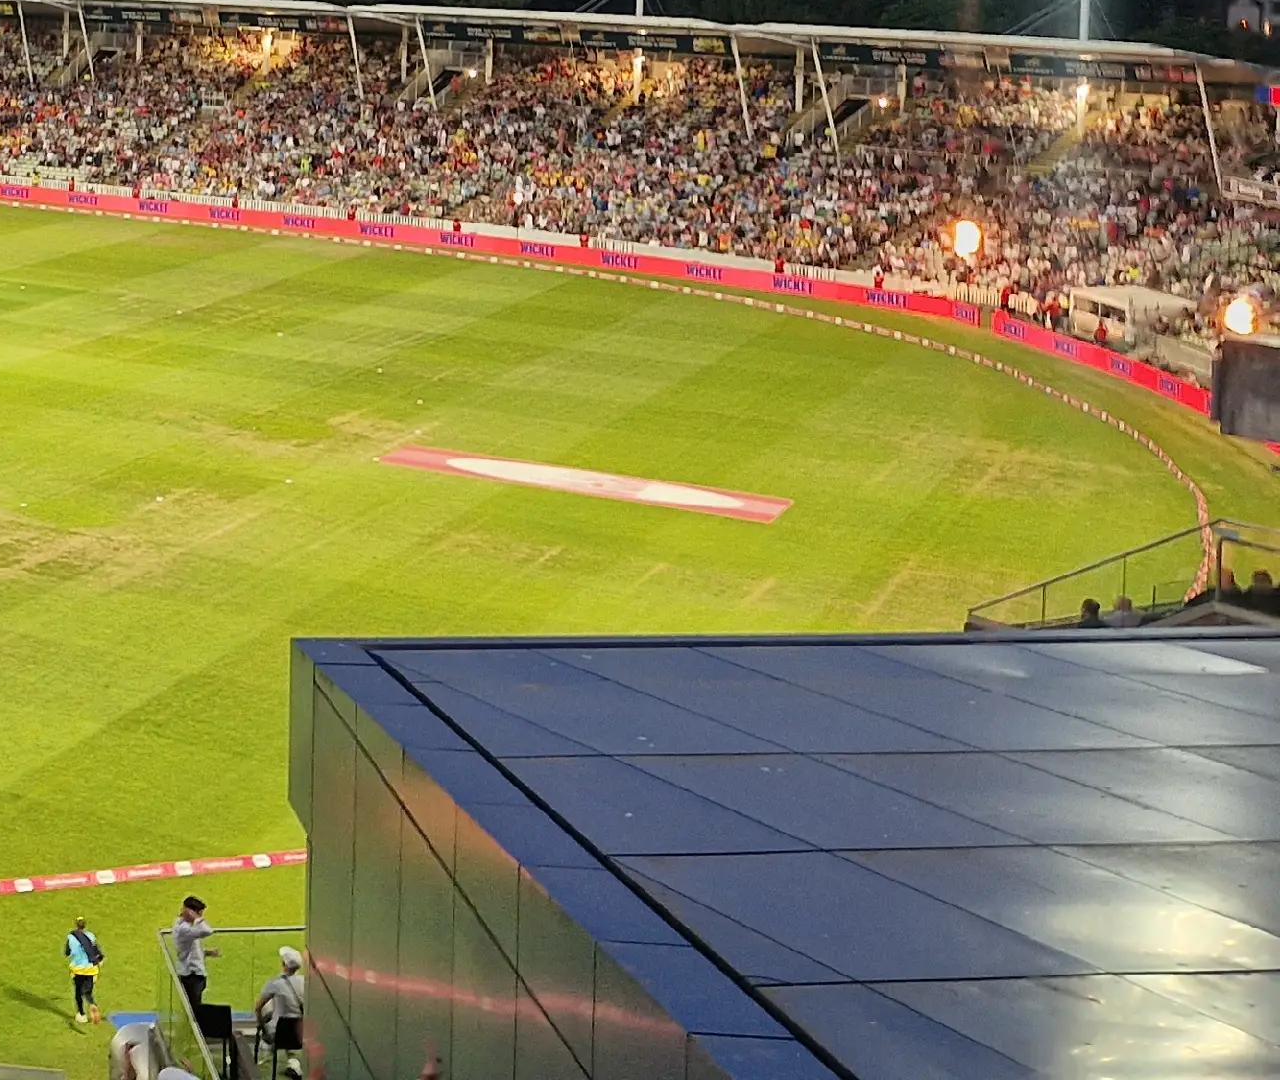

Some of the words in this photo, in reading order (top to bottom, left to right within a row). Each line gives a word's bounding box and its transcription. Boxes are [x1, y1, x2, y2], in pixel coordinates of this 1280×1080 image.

[0, 185, 30, 199] WICKET
[68, 193, 98, 206] WICKET
[138, 200, 168, 214] WICKET
[208, 206, 240, 221] WICKET
[283, 215, 316, 229] WICKET
[359, 222, 395, 239] WICKET
[440, 231, 476, 247] WICKET
[520, 241, 555, 258] WICKET
[601, 251, 640, 269] WICKET
[686, 263, 723, 281] WICKET
[773, 274, 813, 294] WICKET
[866, 289, 907, 309] WICKET
